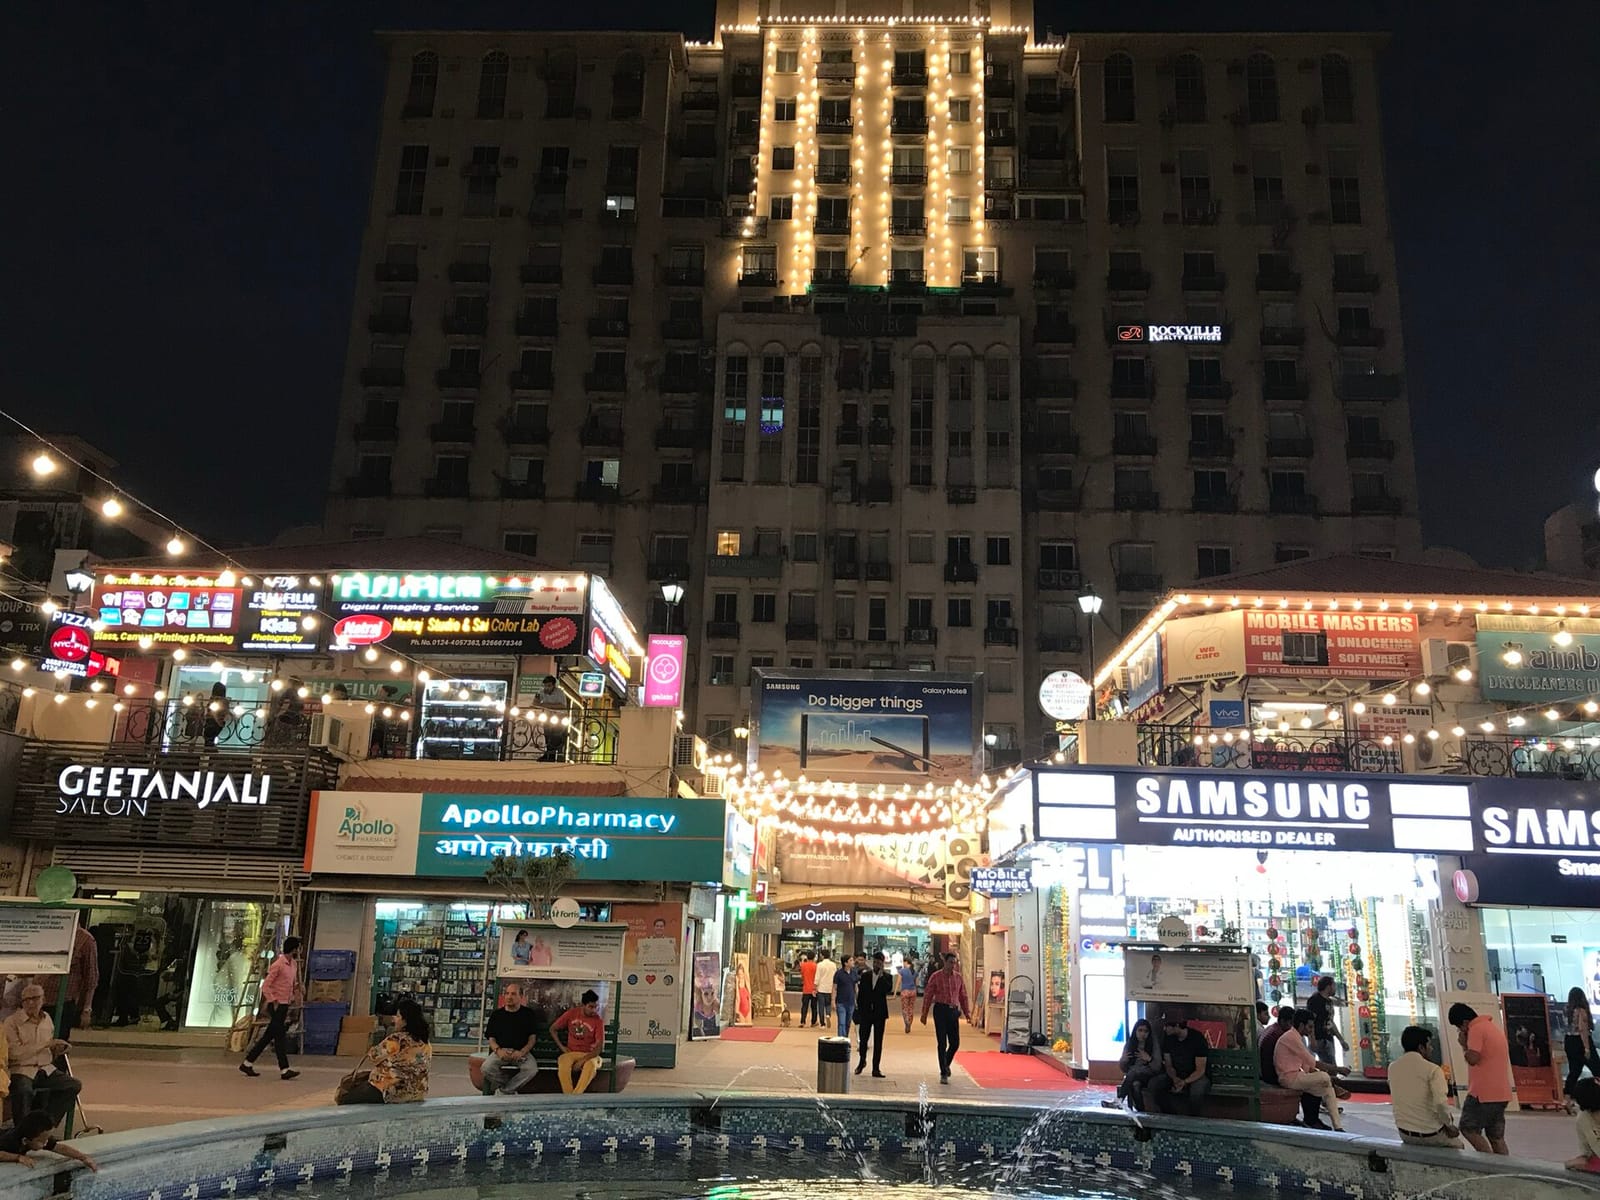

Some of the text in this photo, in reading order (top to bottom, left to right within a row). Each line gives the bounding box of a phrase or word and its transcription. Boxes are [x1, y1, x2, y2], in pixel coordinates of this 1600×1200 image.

[1148, 325, 1222, 341] ROCKVILLE
[341, 602, 480, 613] Digital Imaging Service
[20, 622, 41, 632] TRX
[260, 618, 297, 634] Kids
[427, 617, 461, 633] Studio
[461, 617, 470, 632] &
[471, 617, 490, 632] Sai
[490, 617, 519, 633] Color
[520, 618, 540, 633] Lab
[1247, 612, 1414, 632] MOBILE MASTERS
[154, 633, 189, 643] Printing
[189, 634, 197, 642] &
[196, 634, 234, 645] Framing
[251, 633, 304, 643] Photography
[1337, 637, 1414, 649] UNLOCKING
[1195, 651, 1220, 661] care
[1339, 653, 1404, 664] SOFTWARE
[1343, 669, 1367, 677] PHASE
[766, 683, 801, 691] SAMSUNG
[1488, 674, 1586, 692] DRYCLEANERS
[922, 687, 946, 695] Galaxy
[808, 693, 924, 712] Do bigger things
[1214, 709, 1240, 717] vivo
[1382, 706, 1430, 716] REPAIR
[58, 764, 271, 810] GEETANJALI
[1135, 777, 1371, 820] SAMSUNG
[55, 797, 148, 817] SALON
[338, 818, 394, 842] Apollo
[1172, 827, 1336, 846] AUTHORISED DEALER
[977, 870, 1026, 880] MOBILE
[975, 880, 1029, 889] REPAIRING
[560, 909, 580, 919] Fortis
[805, 910, 851, 923] Opticals
[1167, 929, 1188, 938] Fortis
[214, 994, 255, 1004] BROWS
[646, 1026, 672, 1040] Apollo
